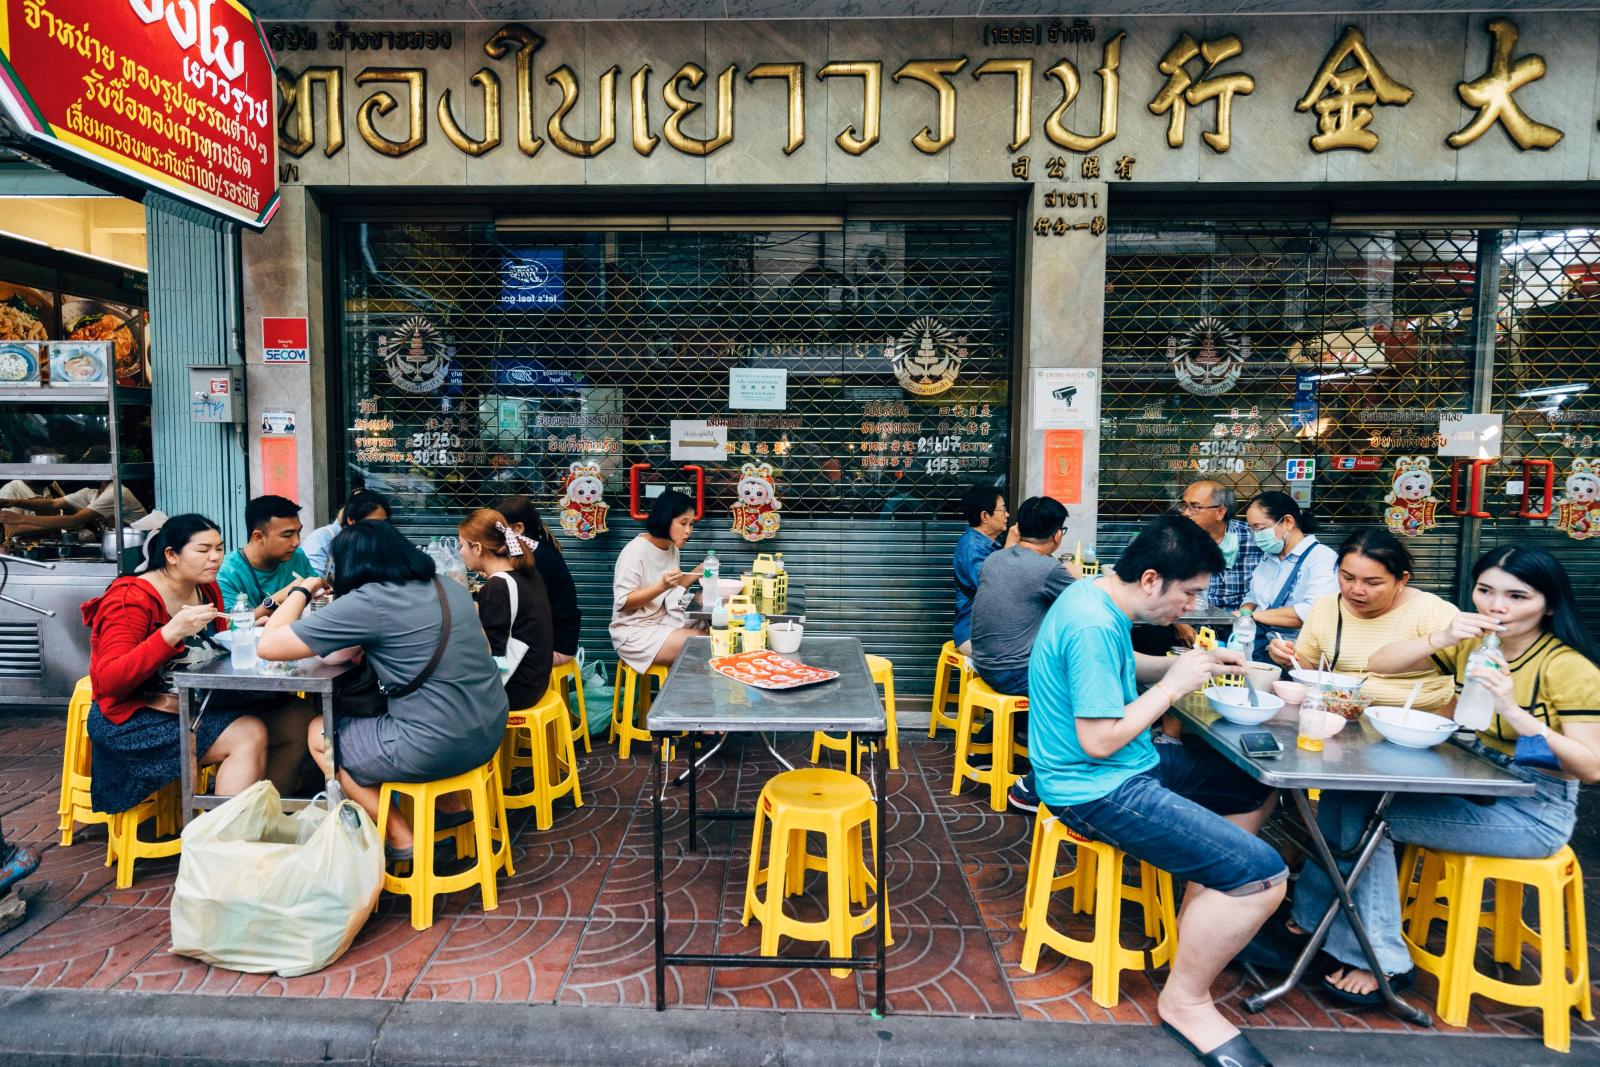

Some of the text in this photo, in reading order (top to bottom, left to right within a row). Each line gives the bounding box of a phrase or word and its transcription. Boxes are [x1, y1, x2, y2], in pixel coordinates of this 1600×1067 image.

[182, 55, 268, 128] เยาวราช
[266, 350, 305, 360] SECOM
